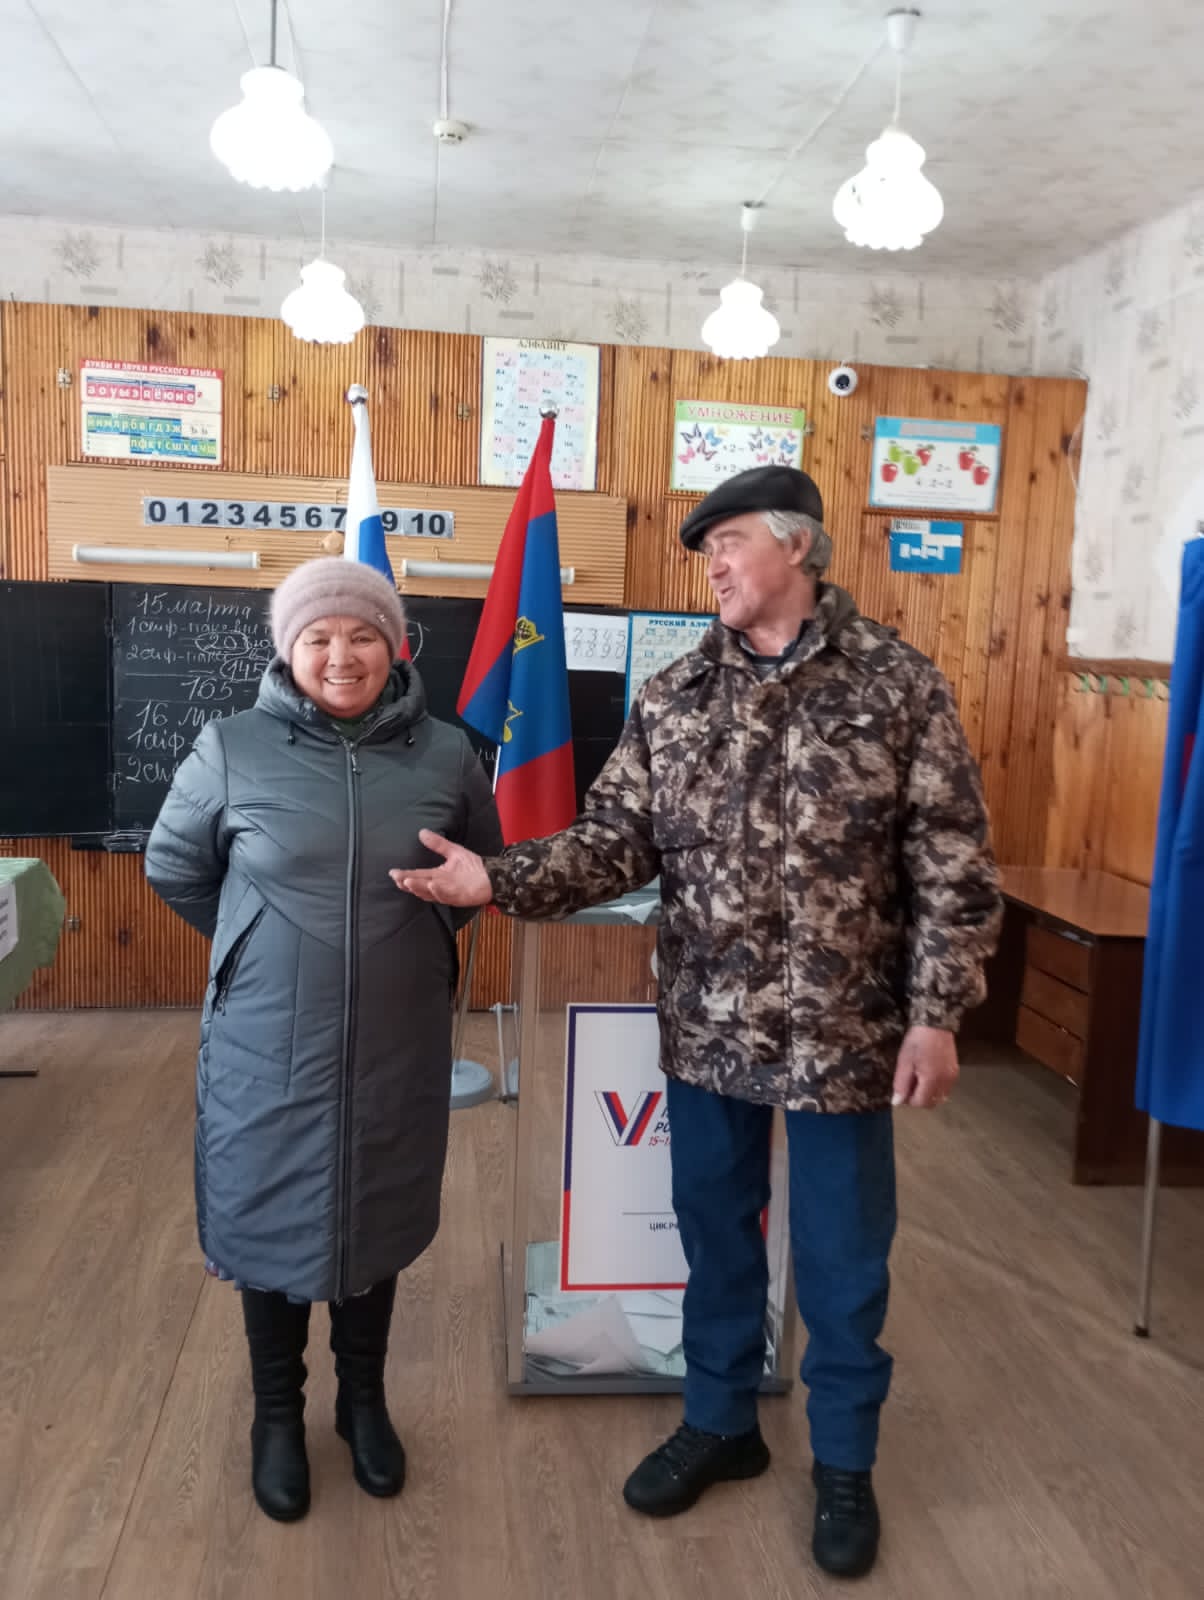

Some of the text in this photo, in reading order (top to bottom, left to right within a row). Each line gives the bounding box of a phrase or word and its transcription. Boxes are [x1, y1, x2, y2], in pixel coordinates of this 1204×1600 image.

[518, 339, 568, 352] АЛФАВИТ
[114, 361, 121, 370] И
[122, 362, 148, 372] ЗВУКИ
[149, 364, 188, 376] РУССКОГО
[190, 367, 217, 378] ЯЗЫКА
[687, 405, 793, 424] УМНОЖЕНИЕ
[149, 501, 166, 523] 0
[176, 502, 189, 523] 1
[201, 503, 219, 524] 2
[227, 503, 245, 526] 3
[253, 505, 271, 527] 4
[279, 506, 297, 527] 5
[305, 507, 322, 528] 6
[411, 512, 446, 535] 10
[137, 592, 168, 614] 15
[649, 619, 710, 629] РУССКИЙ АЛФ
[136, 700, 168, 728] 16
